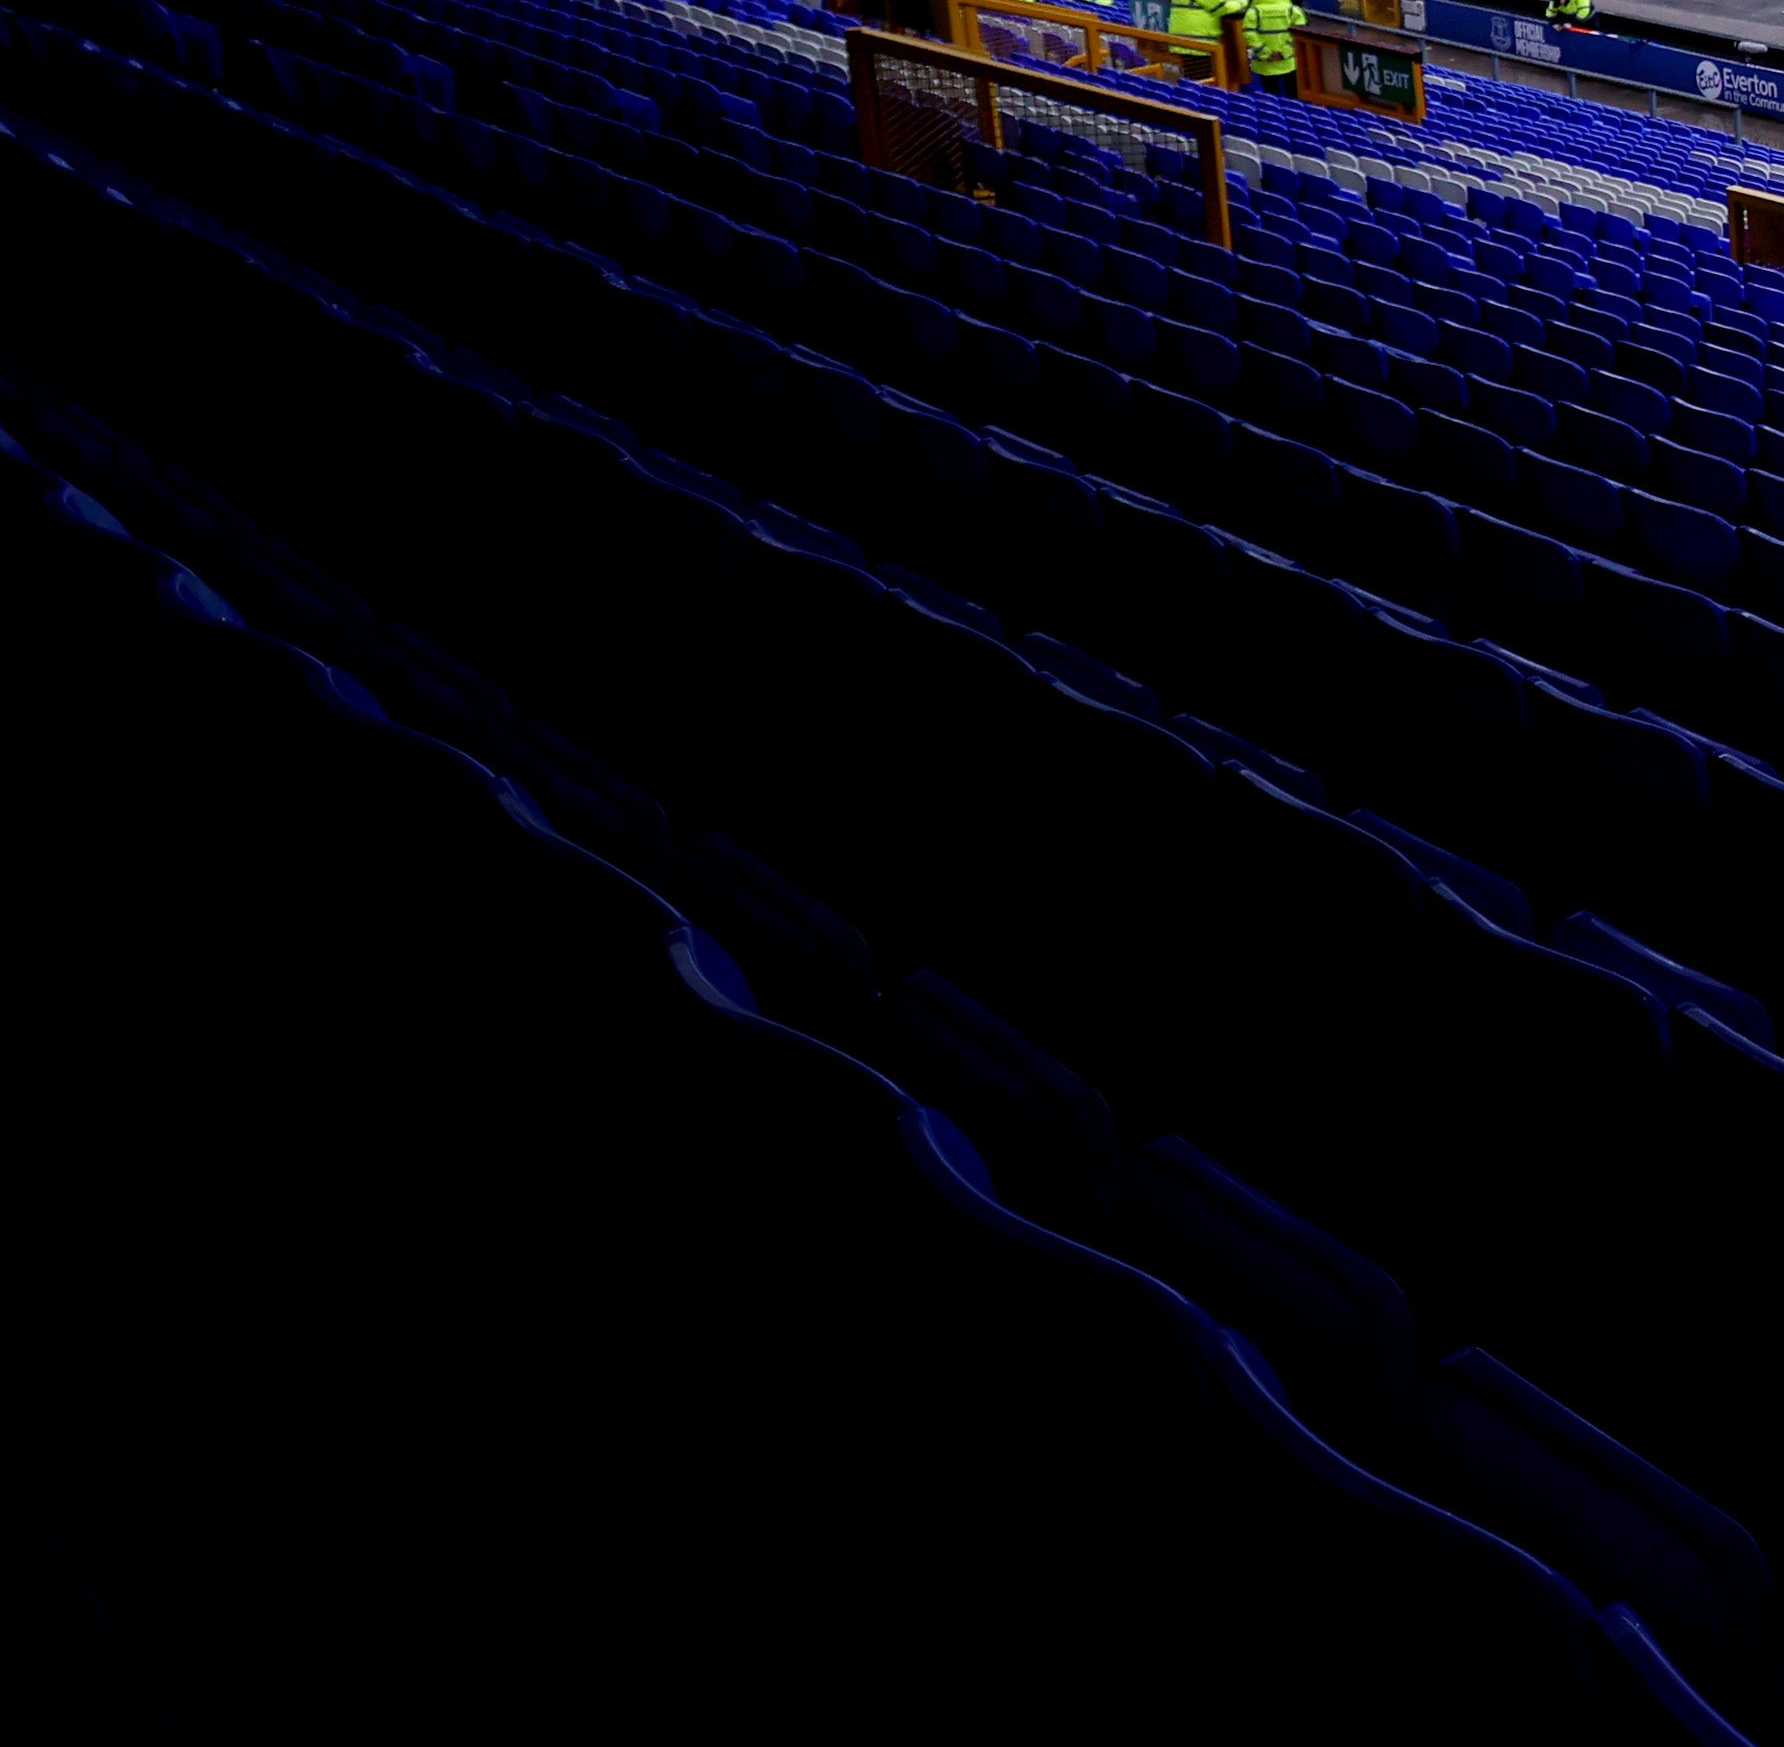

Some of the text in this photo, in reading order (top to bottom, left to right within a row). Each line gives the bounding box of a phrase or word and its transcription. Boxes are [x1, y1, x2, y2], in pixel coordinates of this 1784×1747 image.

[1383, 70, 1410, 90] EXIT
[1723, 67, 1778, 99] Everton
[1724, 88, 1732, 100] in
[1732, 90, 1748, 105] the
